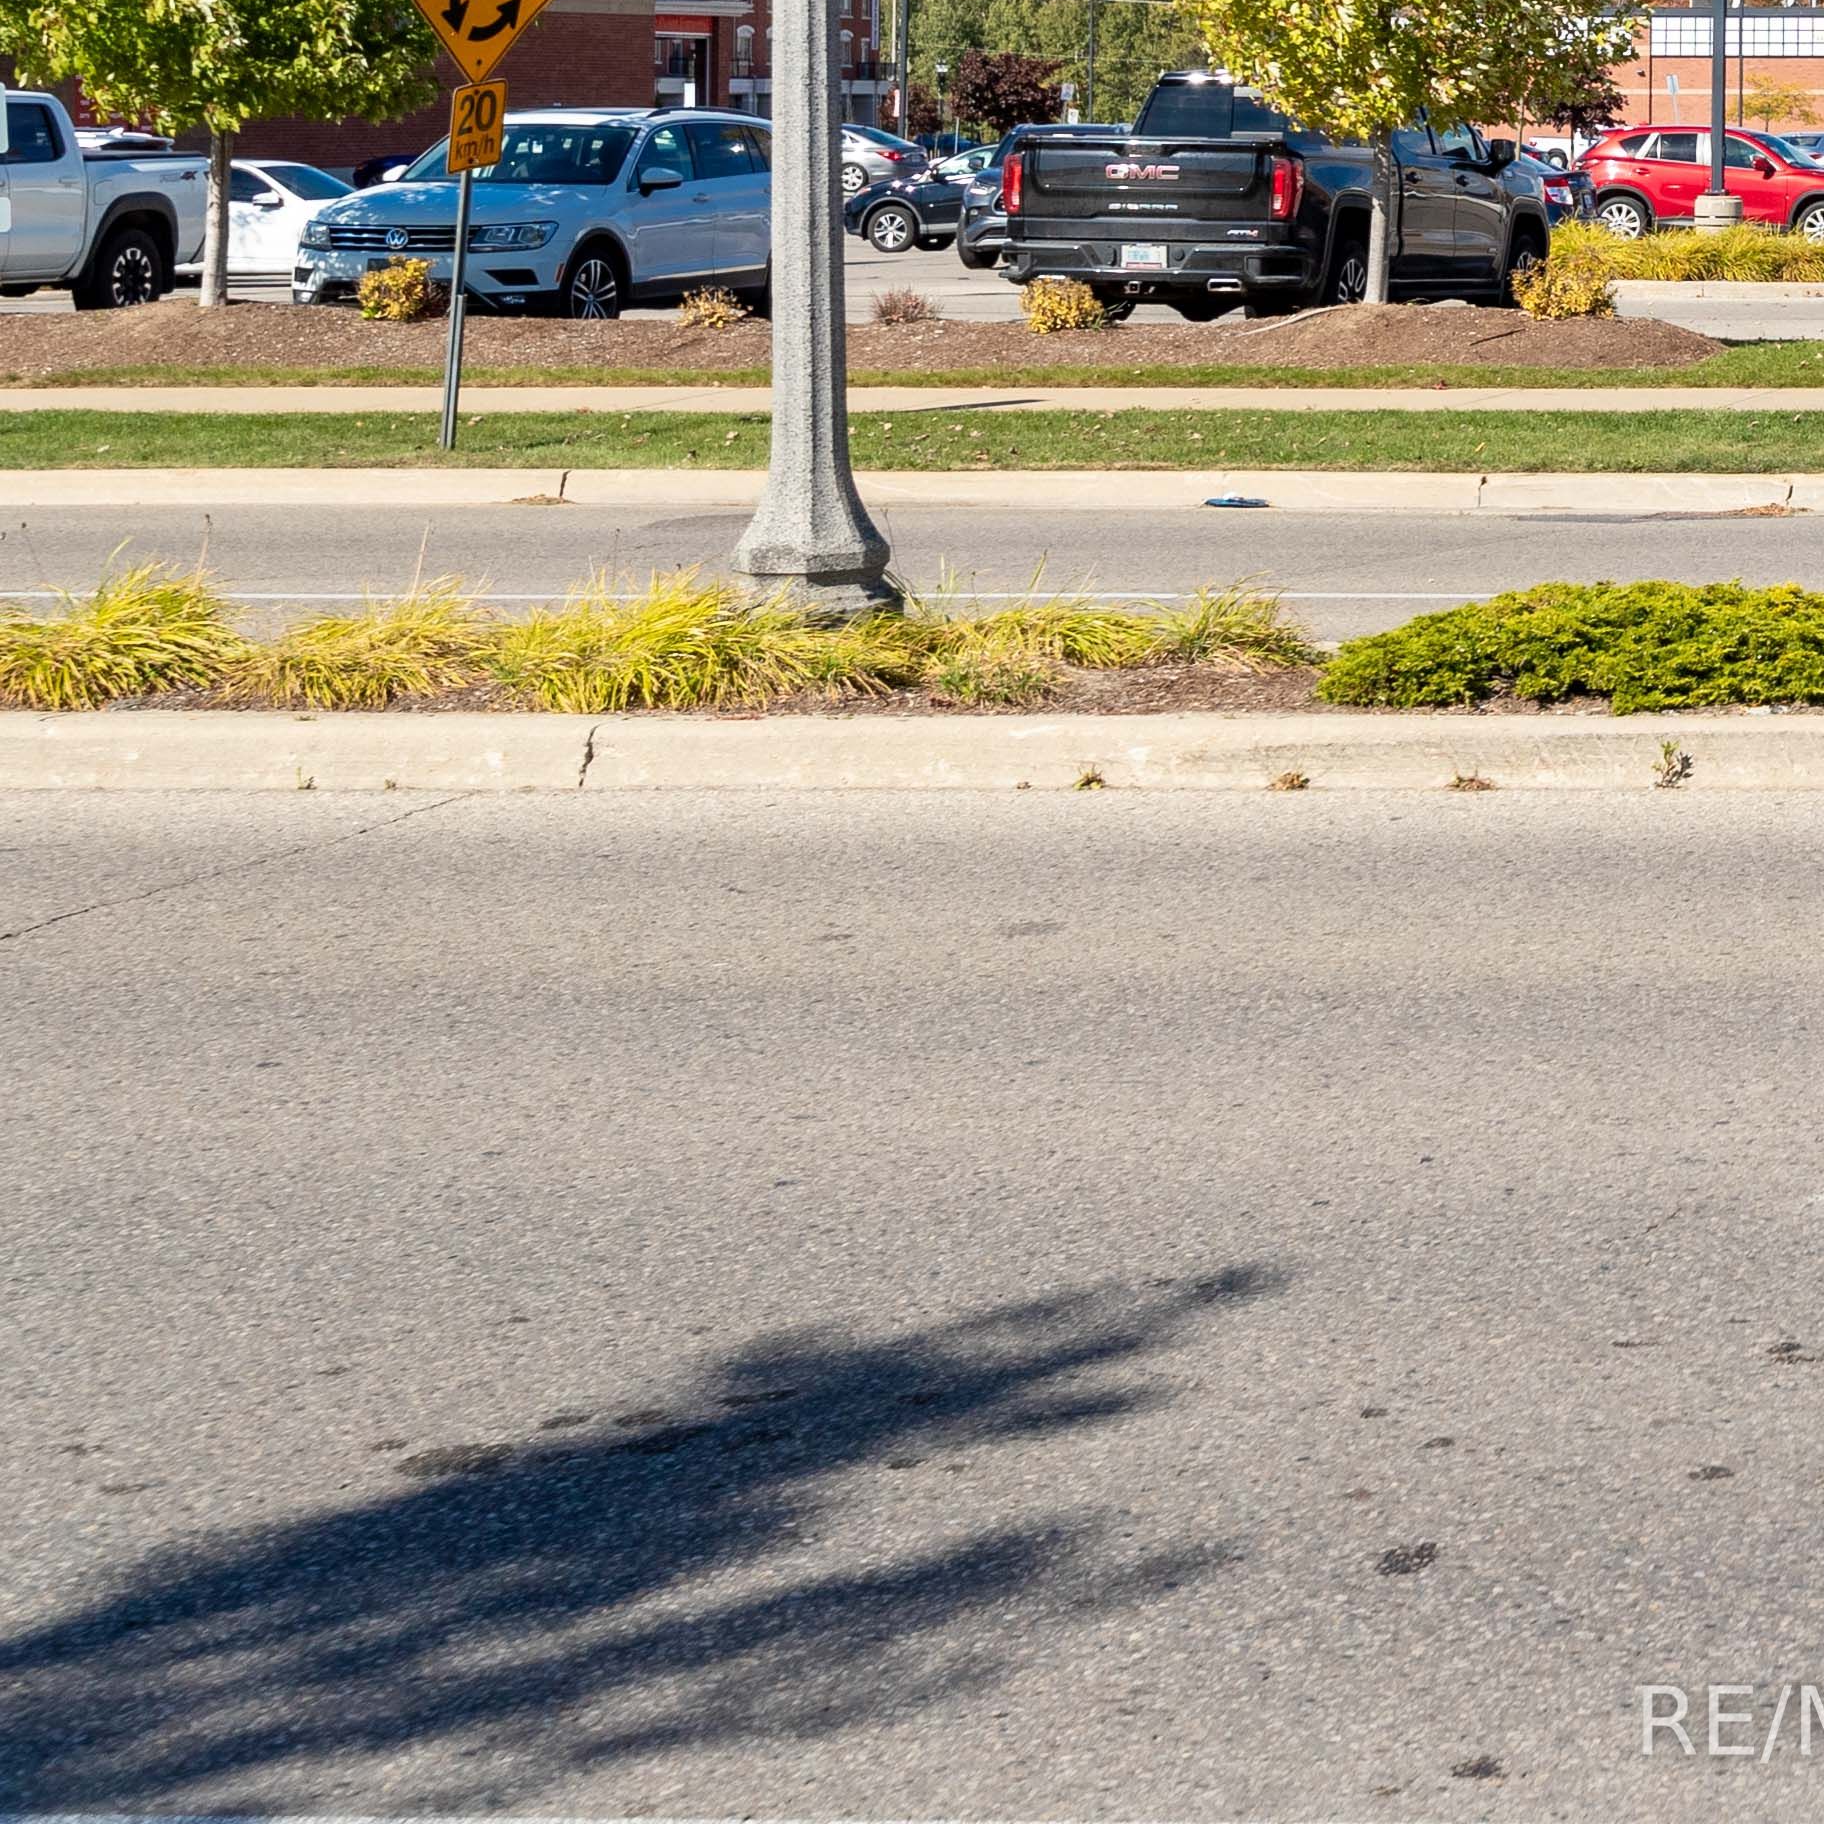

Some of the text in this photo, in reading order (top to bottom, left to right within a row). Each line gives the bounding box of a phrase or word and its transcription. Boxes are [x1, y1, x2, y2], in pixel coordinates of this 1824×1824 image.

[457, 89, 497, 137] 20
[455, 133, 495, 160] km/h
[1105, 164, 1180, 180] GMC
